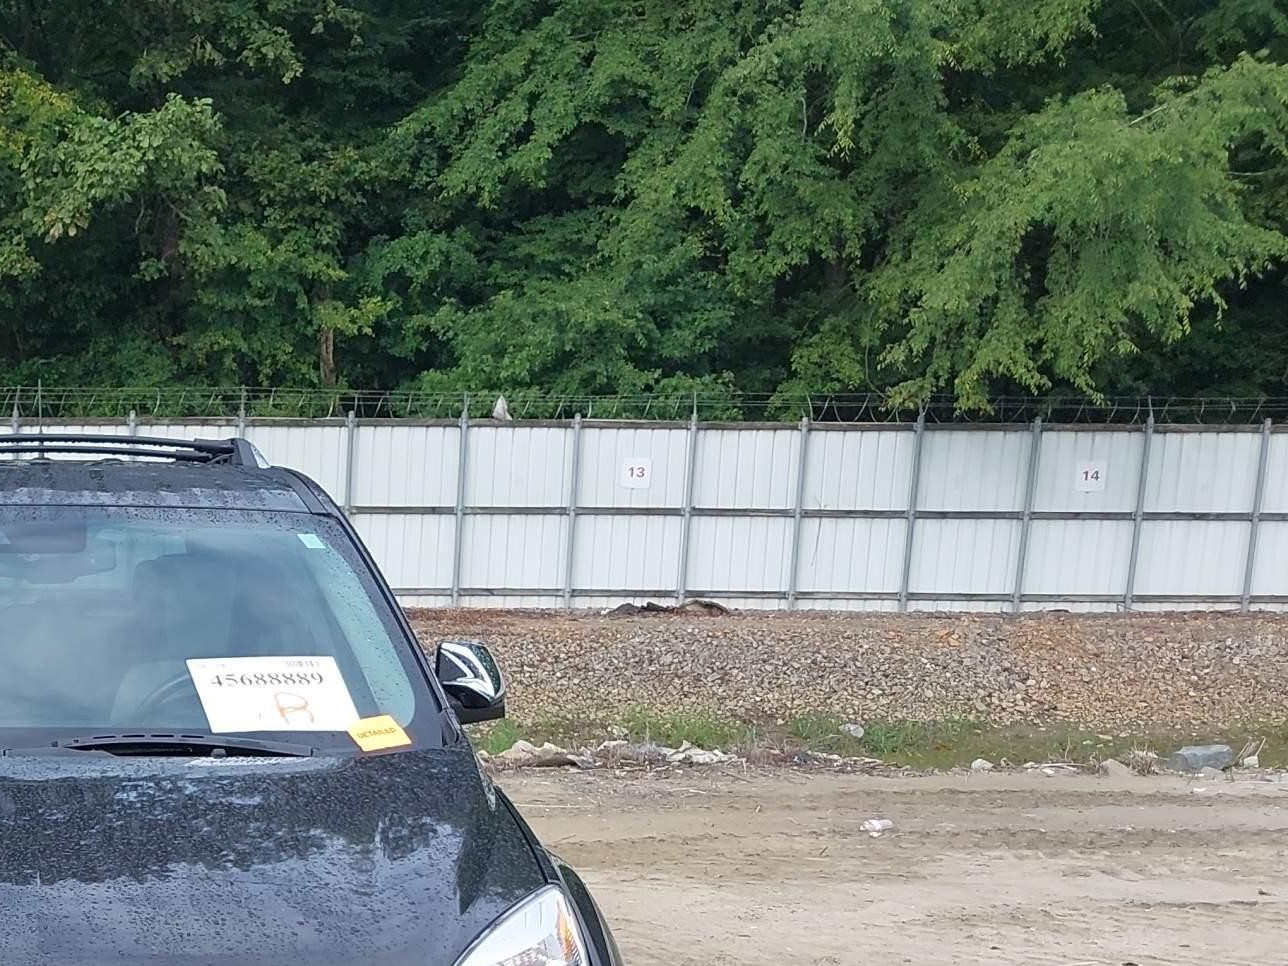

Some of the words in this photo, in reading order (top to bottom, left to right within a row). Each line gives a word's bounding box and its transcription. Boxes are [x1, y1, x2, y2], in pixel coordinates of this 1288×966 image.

[628, 467, 645, 478] 13
[1082, 470, 1100, 482] 14
[211, 672, 324, 687] 45688889
